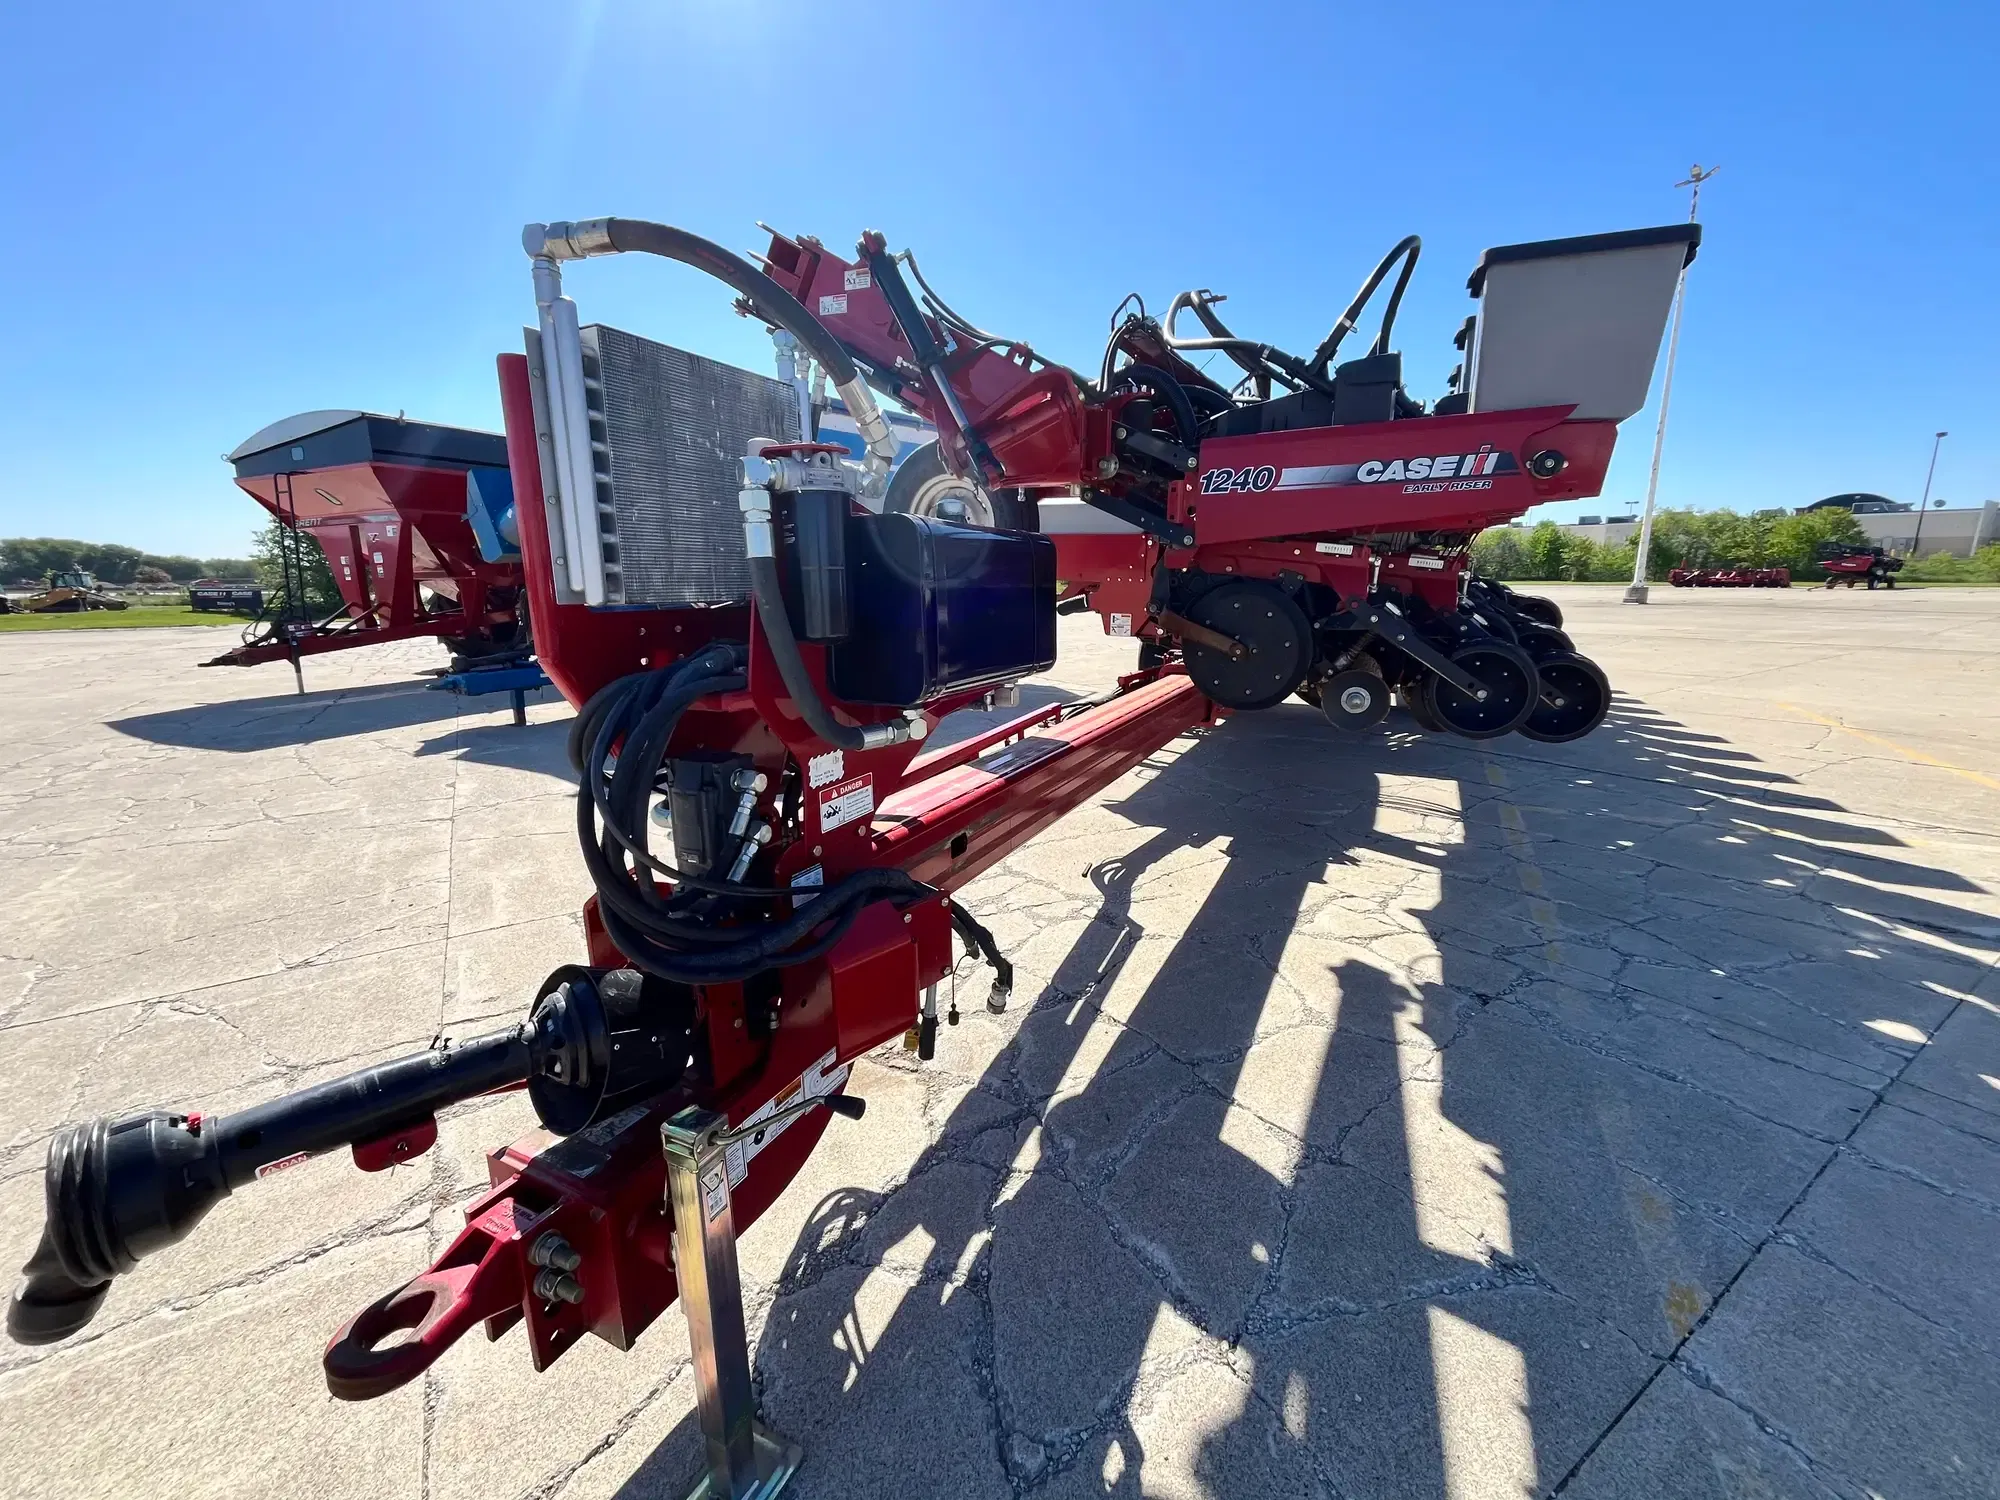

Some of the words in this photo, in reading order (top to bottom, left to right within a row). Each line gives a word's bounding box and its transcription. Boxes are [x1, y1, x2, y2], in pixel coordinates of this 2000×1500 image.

[1357, 456, 1460, 482] CASE
[1200, 465, 1276, 494] 1240
[1402, 482, 1449, 494] EARLY
[1449, 480, 1493, 491] RISER
[840, 780, 863, 795] DANGER
